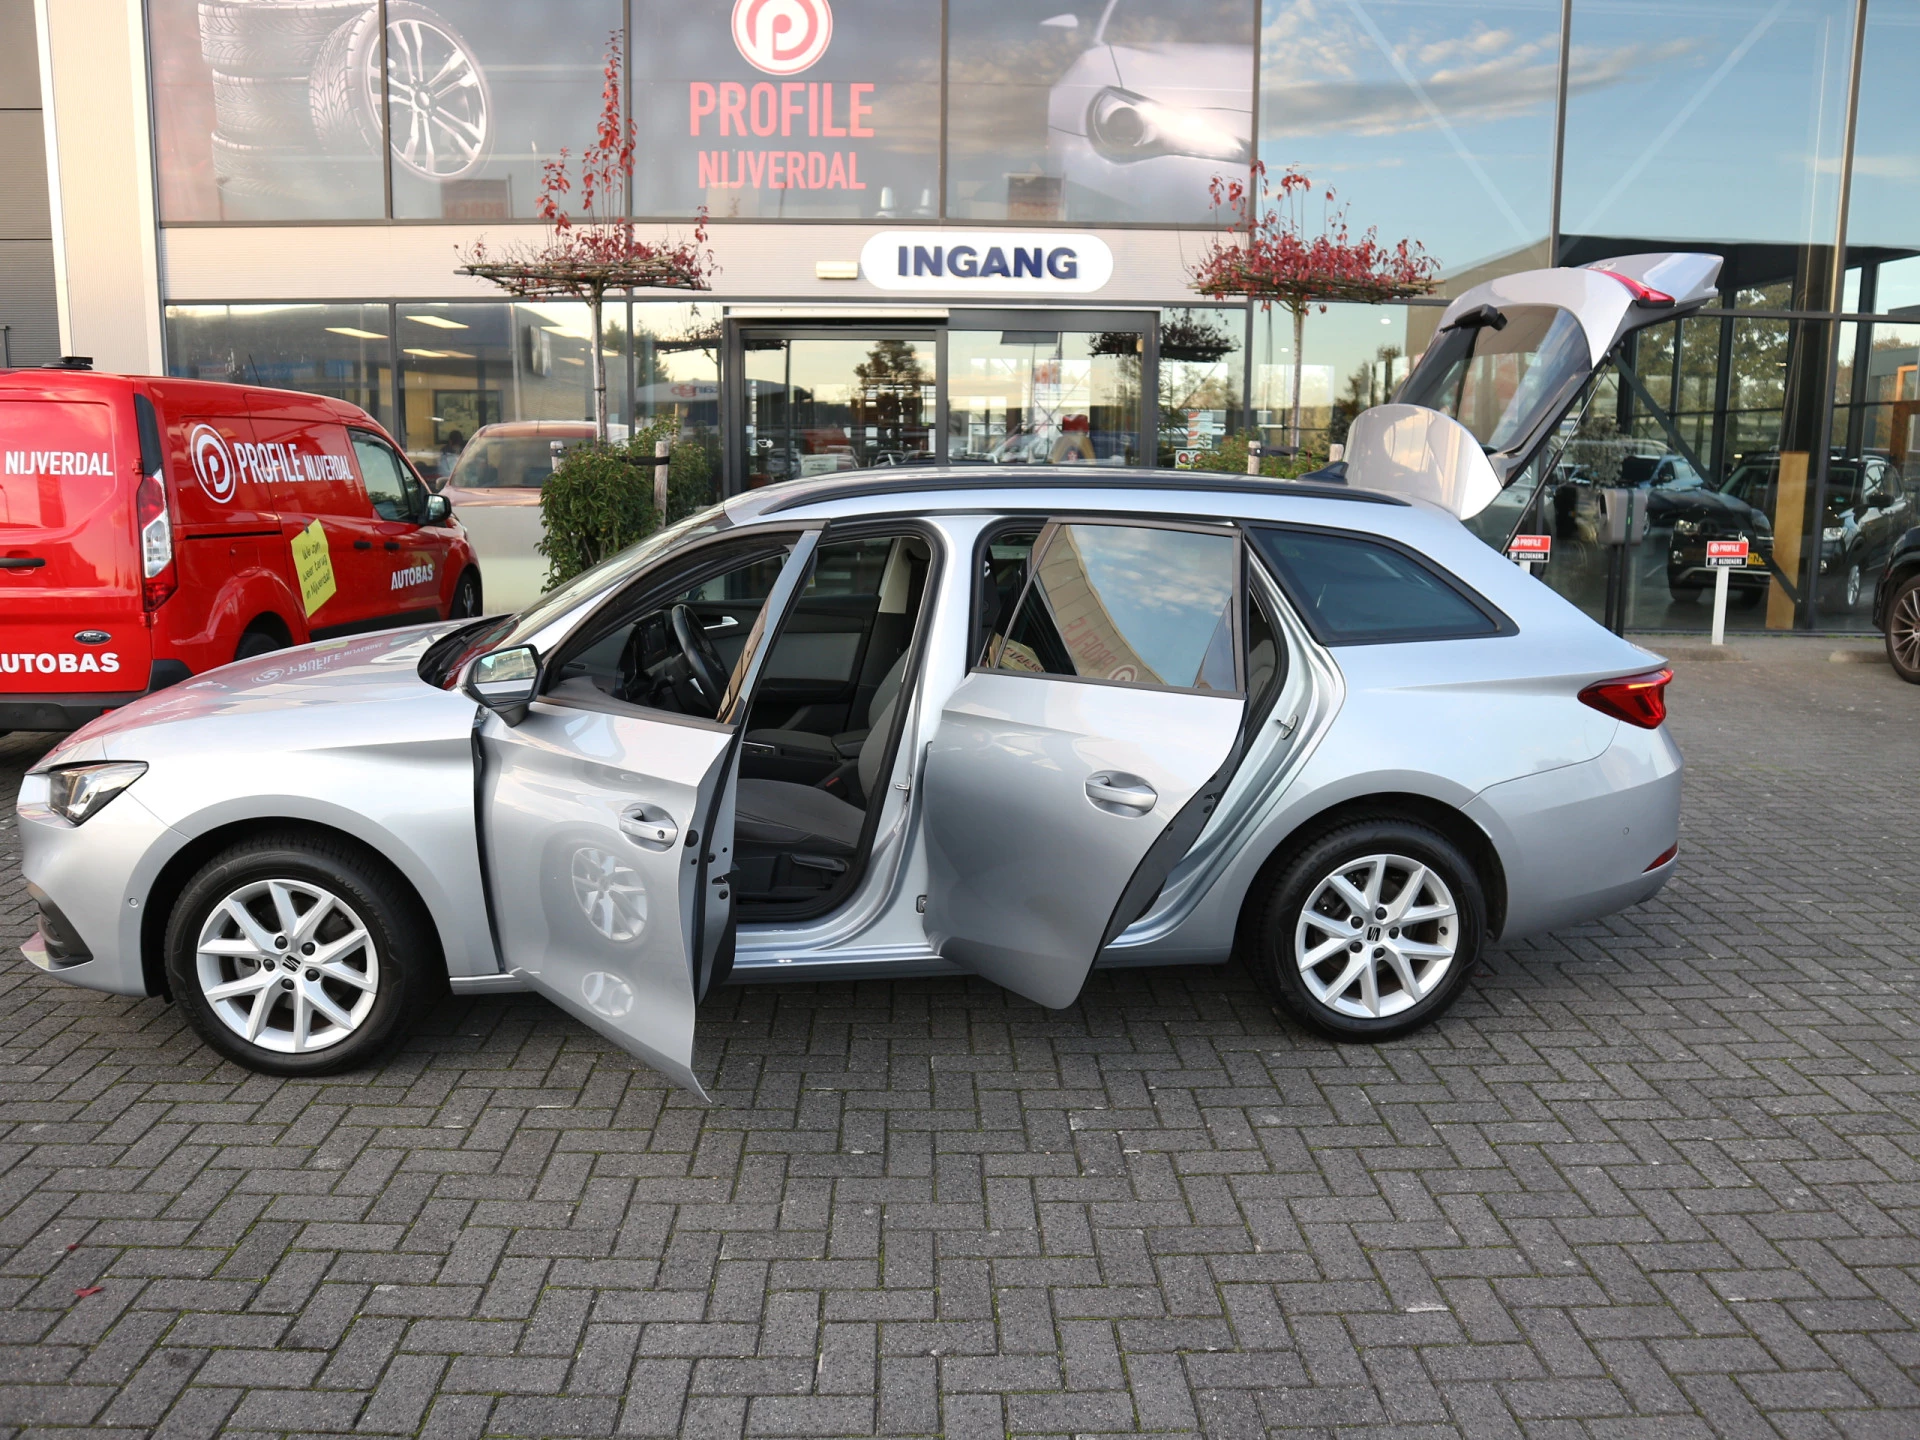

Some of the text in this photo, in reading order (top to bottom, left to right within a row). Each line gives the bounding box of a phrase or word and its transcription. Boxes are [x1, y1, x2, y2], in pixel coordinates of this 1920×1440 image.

[689, 82, 875, 138] PROFILE
[698, 151, 866, 190] NIJVERDAL
[897, 246, 1078, 280] INGANG
[5, 450, 114, 477] NIJVERDAL
[233, 442, 305, 484] PROFILE
[303, 455, 354, 482] NIJVERDAL
[1520, 538, 1543, 547] PROFILE
[1719, 543, 1741, 553] PROFILE
[391, 563, 434, 590] AUTOBAS
[0, 652, 120, 674] UTOBAS
